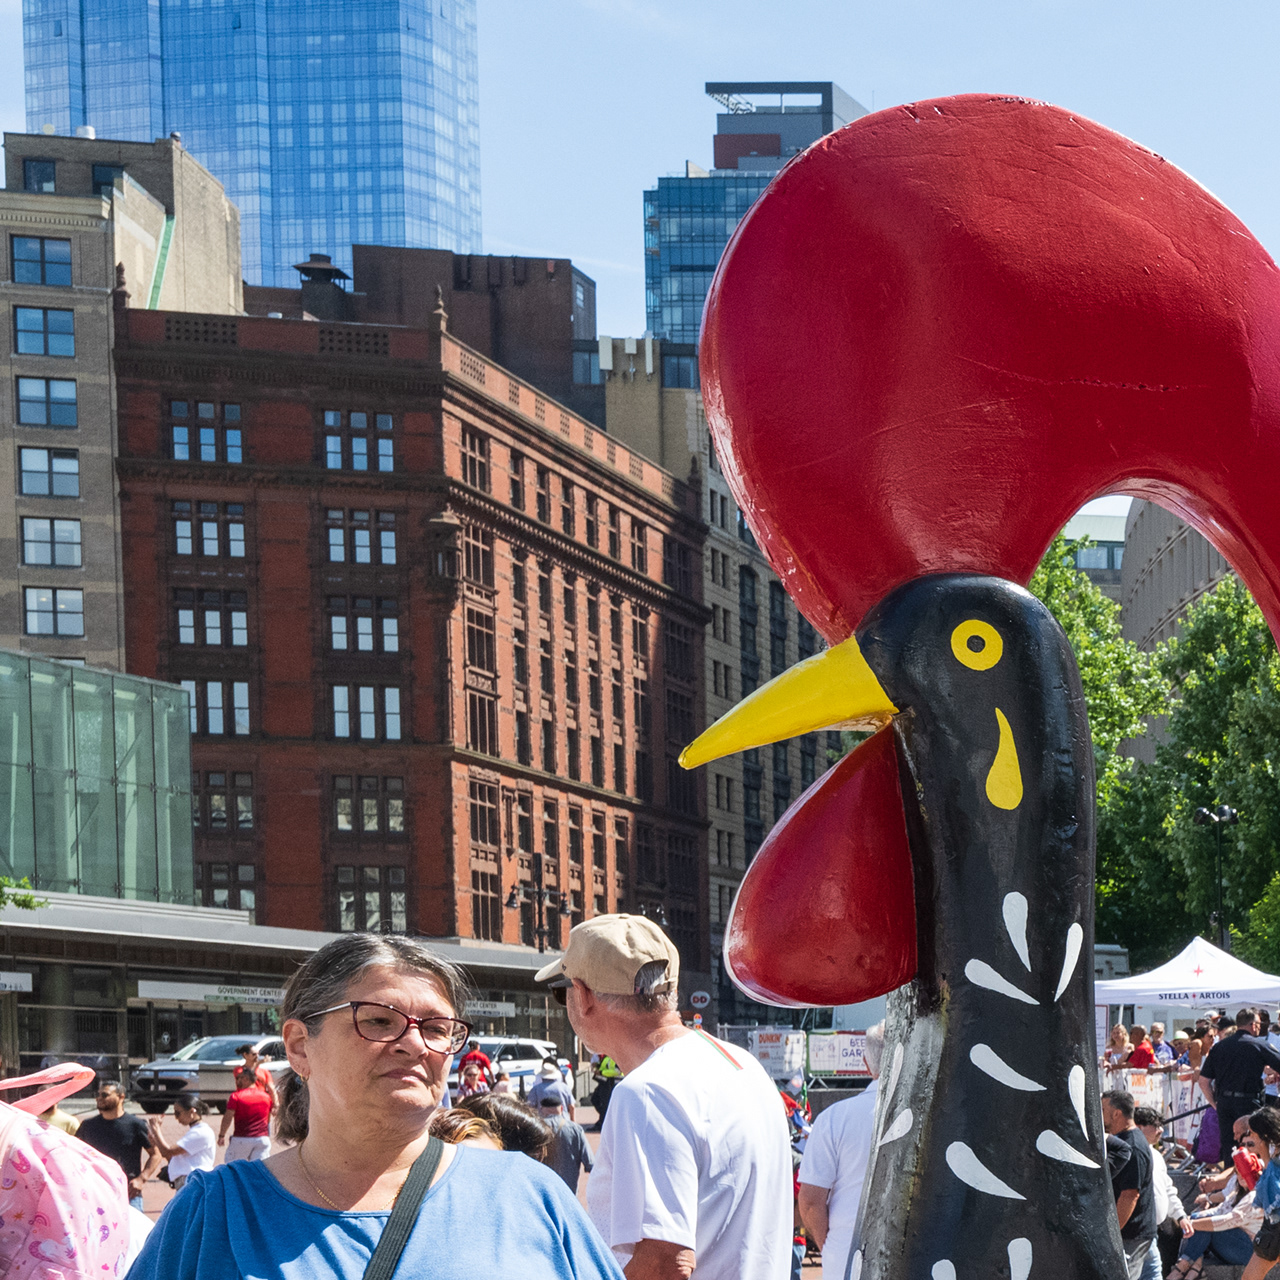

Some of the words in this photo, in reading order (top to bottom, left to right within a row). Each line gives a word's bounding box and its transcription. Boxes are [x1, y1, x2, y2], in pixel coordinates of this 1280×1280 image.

[217, 986, 258, 996] GOVERNMENT
[1158, 993, 1190, 1001] STELLA
[1199, 991, 1231, 1000] ARTOIS
[849, 1038, 866, 1048] BEE
